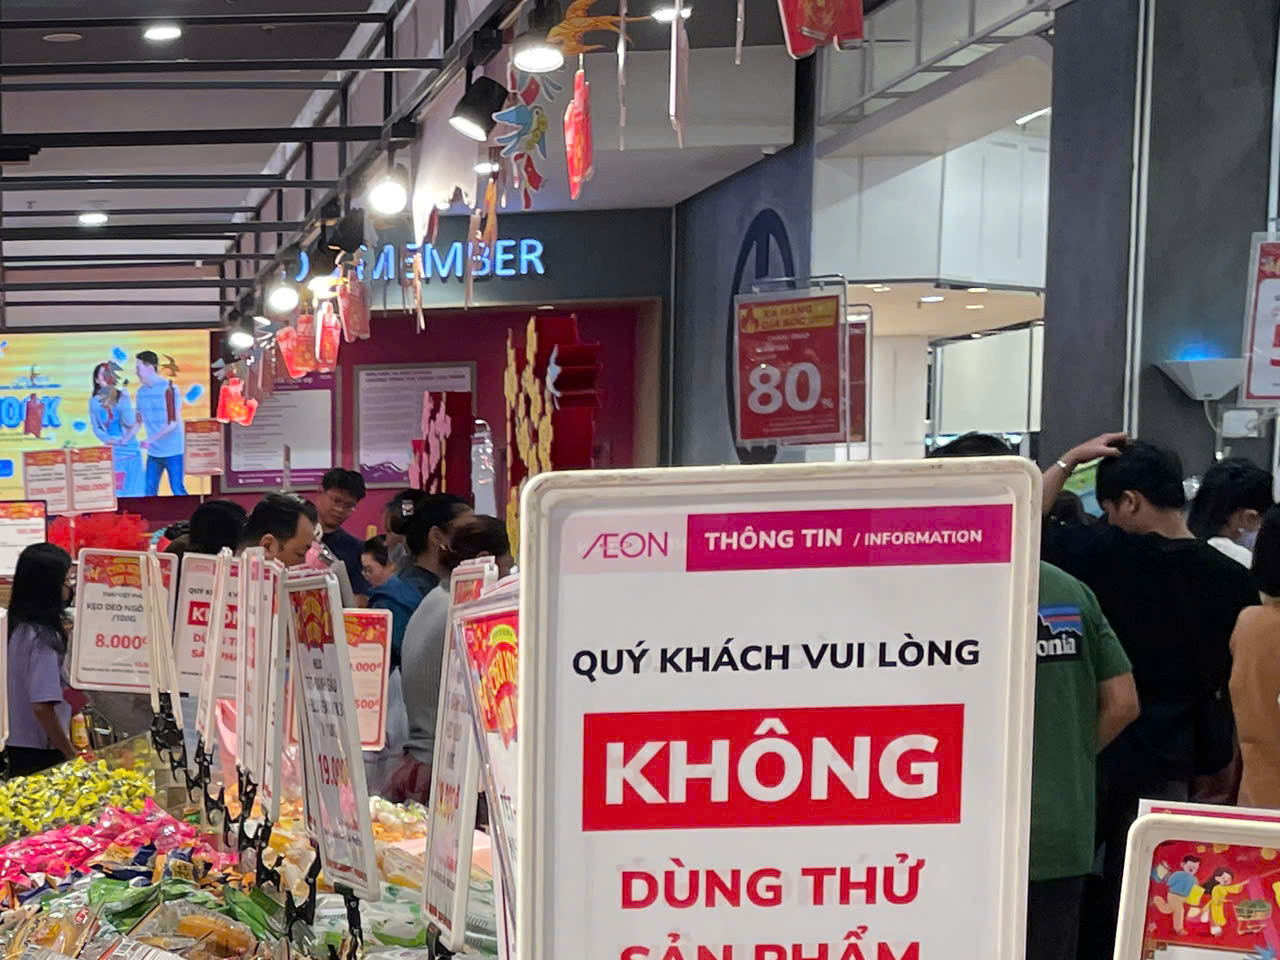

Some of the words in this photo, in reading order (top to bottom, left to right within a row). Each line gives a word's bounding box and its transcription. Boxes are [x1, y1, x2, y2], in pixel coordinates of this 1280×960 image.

[748, 362, 822, 415] 80
[704, 525, 794, 553] THÔNG
[801, 528, 843, 549] TIN
[864, 529, 983, 547] INFORMATION
[572, 639, 648, 683] QUÝ
[660, 638, 790, 674] KHÁCH
[801, 642, 866, 670] VUI
[877, 633, 981, 668] LÒNG
[605, 718, 940, 806] KHÔNG
[621, 857, 783, 910] DÙNG
[801, 853, 926, 907] THỬ
